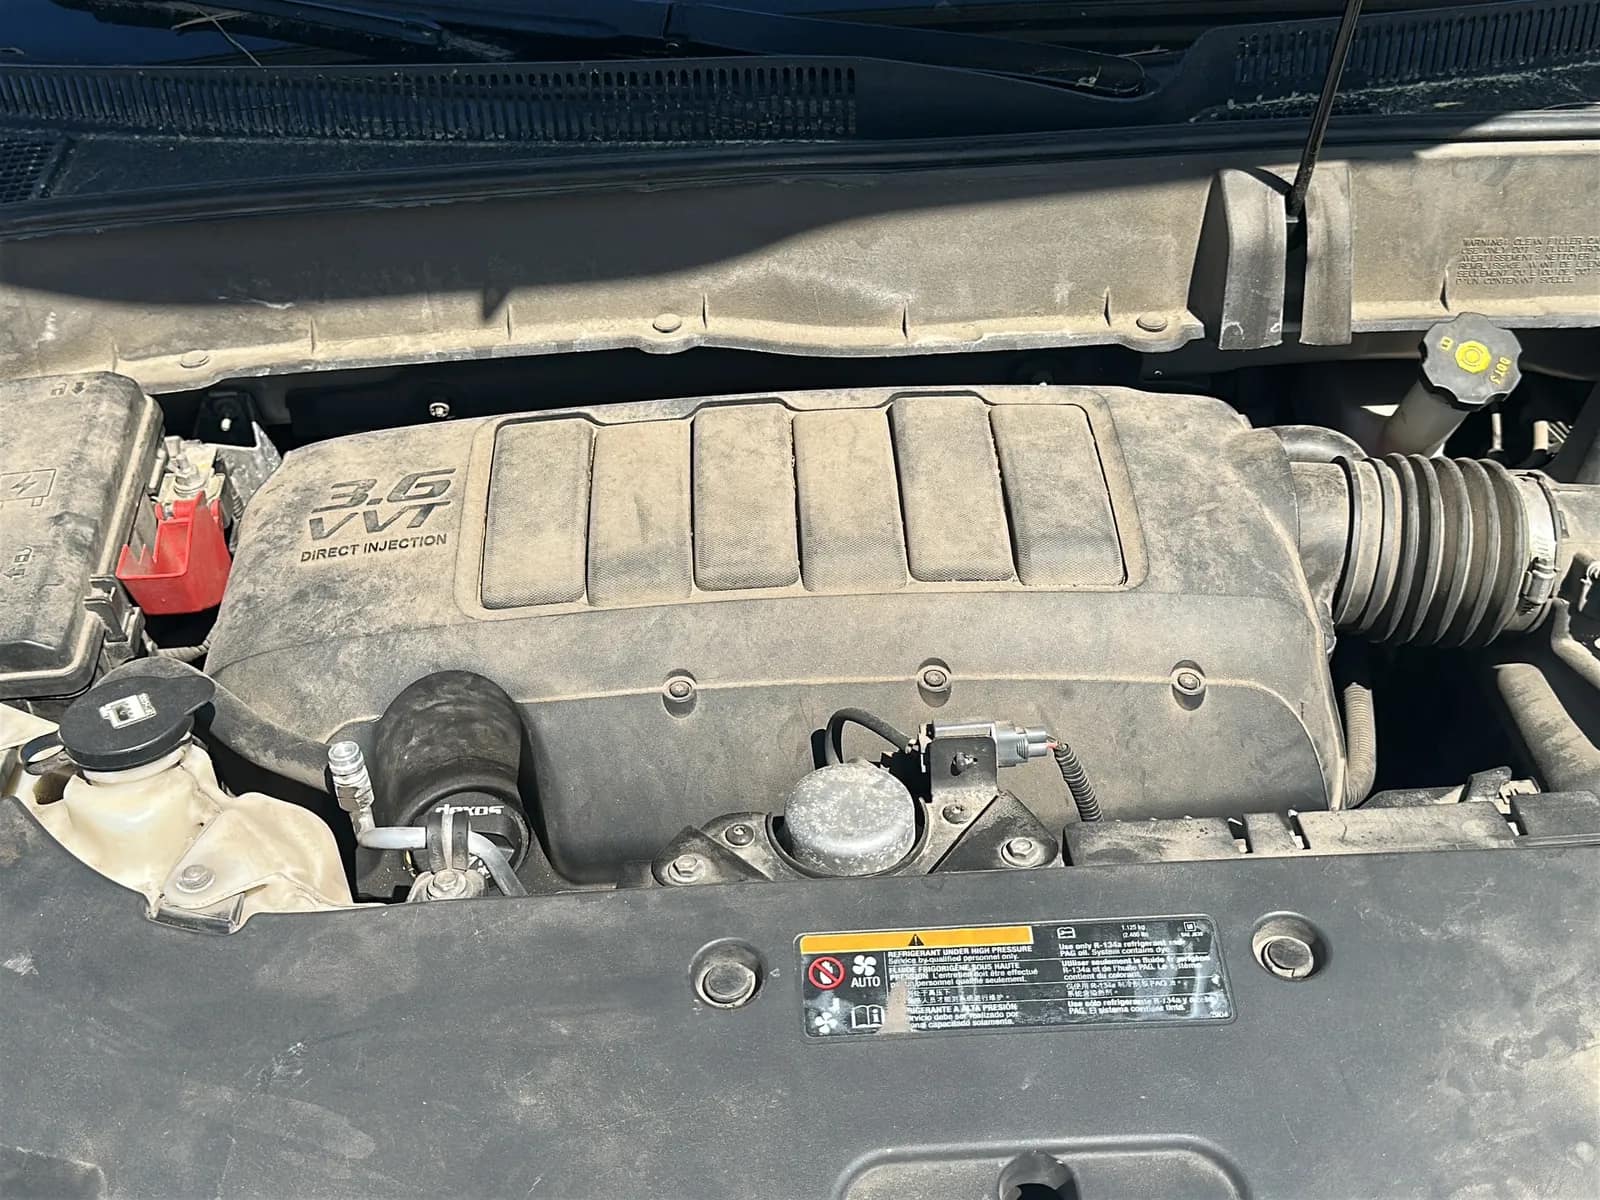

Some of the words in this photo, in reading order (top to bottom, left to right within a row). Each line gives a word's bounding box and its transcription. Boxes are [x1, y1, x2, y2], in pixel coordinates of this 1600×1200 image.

[311, 468, 456, 514] 3.6
[309, 501, 451, 541] VVT
[300, 543, 359, 562] DIRECT
[363, 533, 447, 553] INJECTION
[888, 949, 941, 958] REFRIGERANT
[992, 945, 1033, 953] PRESSURE
[1075, 942, 1093, 951] only
[1093, 941, 1122, 949] R-134a
[964, 953, 1000, 962] personnel
[1091, 957, 1133, 966] seulement
[994, 962, 1021, 970] HAUTE
[1007, 968, 1038, 976] effectué
[850, 975, 881, 988] AUTO
